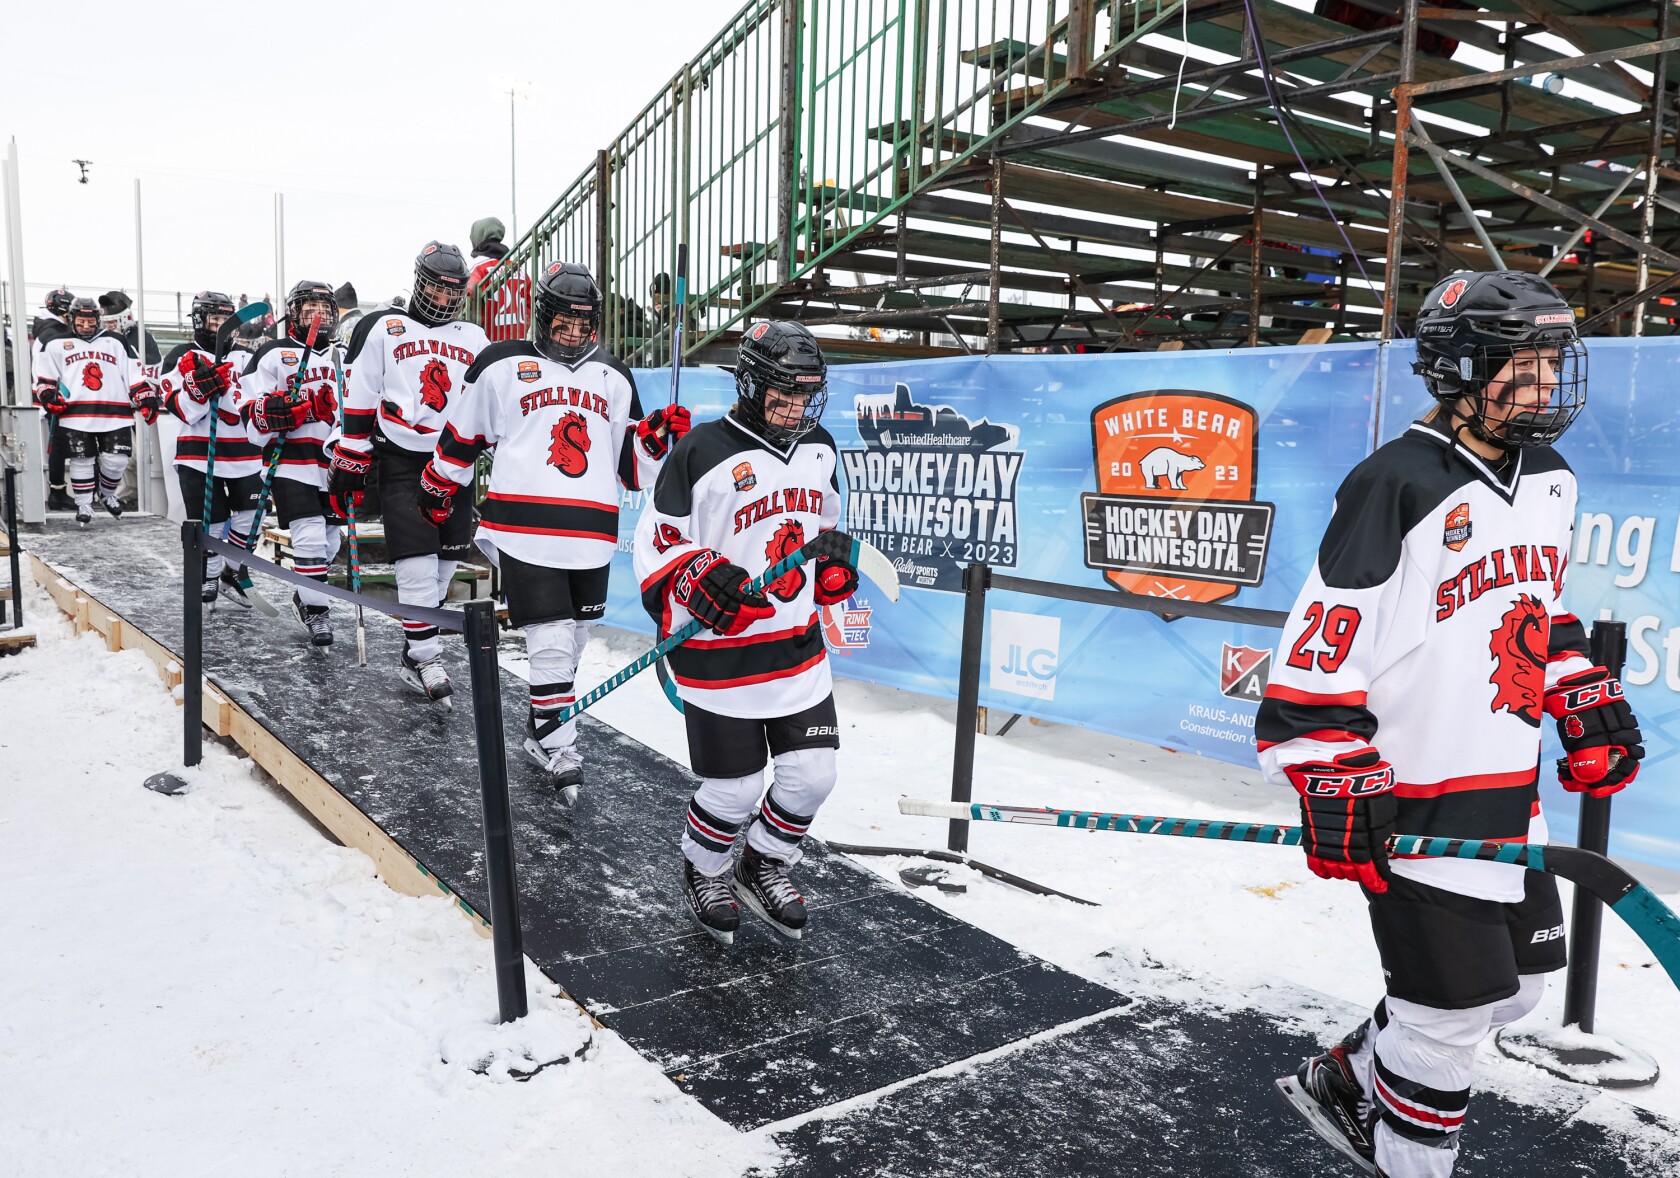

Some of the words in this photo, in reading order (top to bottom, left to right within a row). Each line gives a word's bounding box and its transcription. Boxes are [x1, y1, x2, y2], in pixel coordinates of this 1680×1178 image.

[65, 351, 117, 367] STILLWATER
[393, 340, 475, 366] STILLWATER
[1104, 408, 1168, 437] WHITE
[1182, 408, 1241, 439] BEAR
[896, 433, 971, 446] UnitedHealthcare
[334, 456, 369, 473] CM
[844, 452, 953, 495] HOCKEY
[954, 453, 1020, 499] DAY
[1111, 462, 1132, 477] 20
[1215, 465, 1238, 480] 23
[421, 476, 451, 497] CM
[734, 488, 823, 535] STILLWAT
[849, 492, 1014, 544] MINNESOTA
[1105, 506, 1192, 539] HOCKEY
[1197, 512, 1244, 542] DAY
[901, 537, 933, 556] BEAR
[963, 544, 1013, 564] 2023
[1106, 534, 1239, 572] MINNESOTA
[1569, 512, 1656, 588] ng
[916, 565, 938, 577] SPORTS
[845, 612, 868, 625] RINK
[1286, 601, 1361, 673] 29
[1000, 644, 1057, 681] JLG
[1227, 650, 1243, 672] K
[1245, 674, 1262, 696] A
[1189, 704, 1256, 728] KRAUS-AND
[1180, 719, 1247, 744] Construction
[1573, 759, 1596, 767] CCM
[1303, 765, 1395, 797] CC
[1334, 1104, 1358, 1138] CCM
